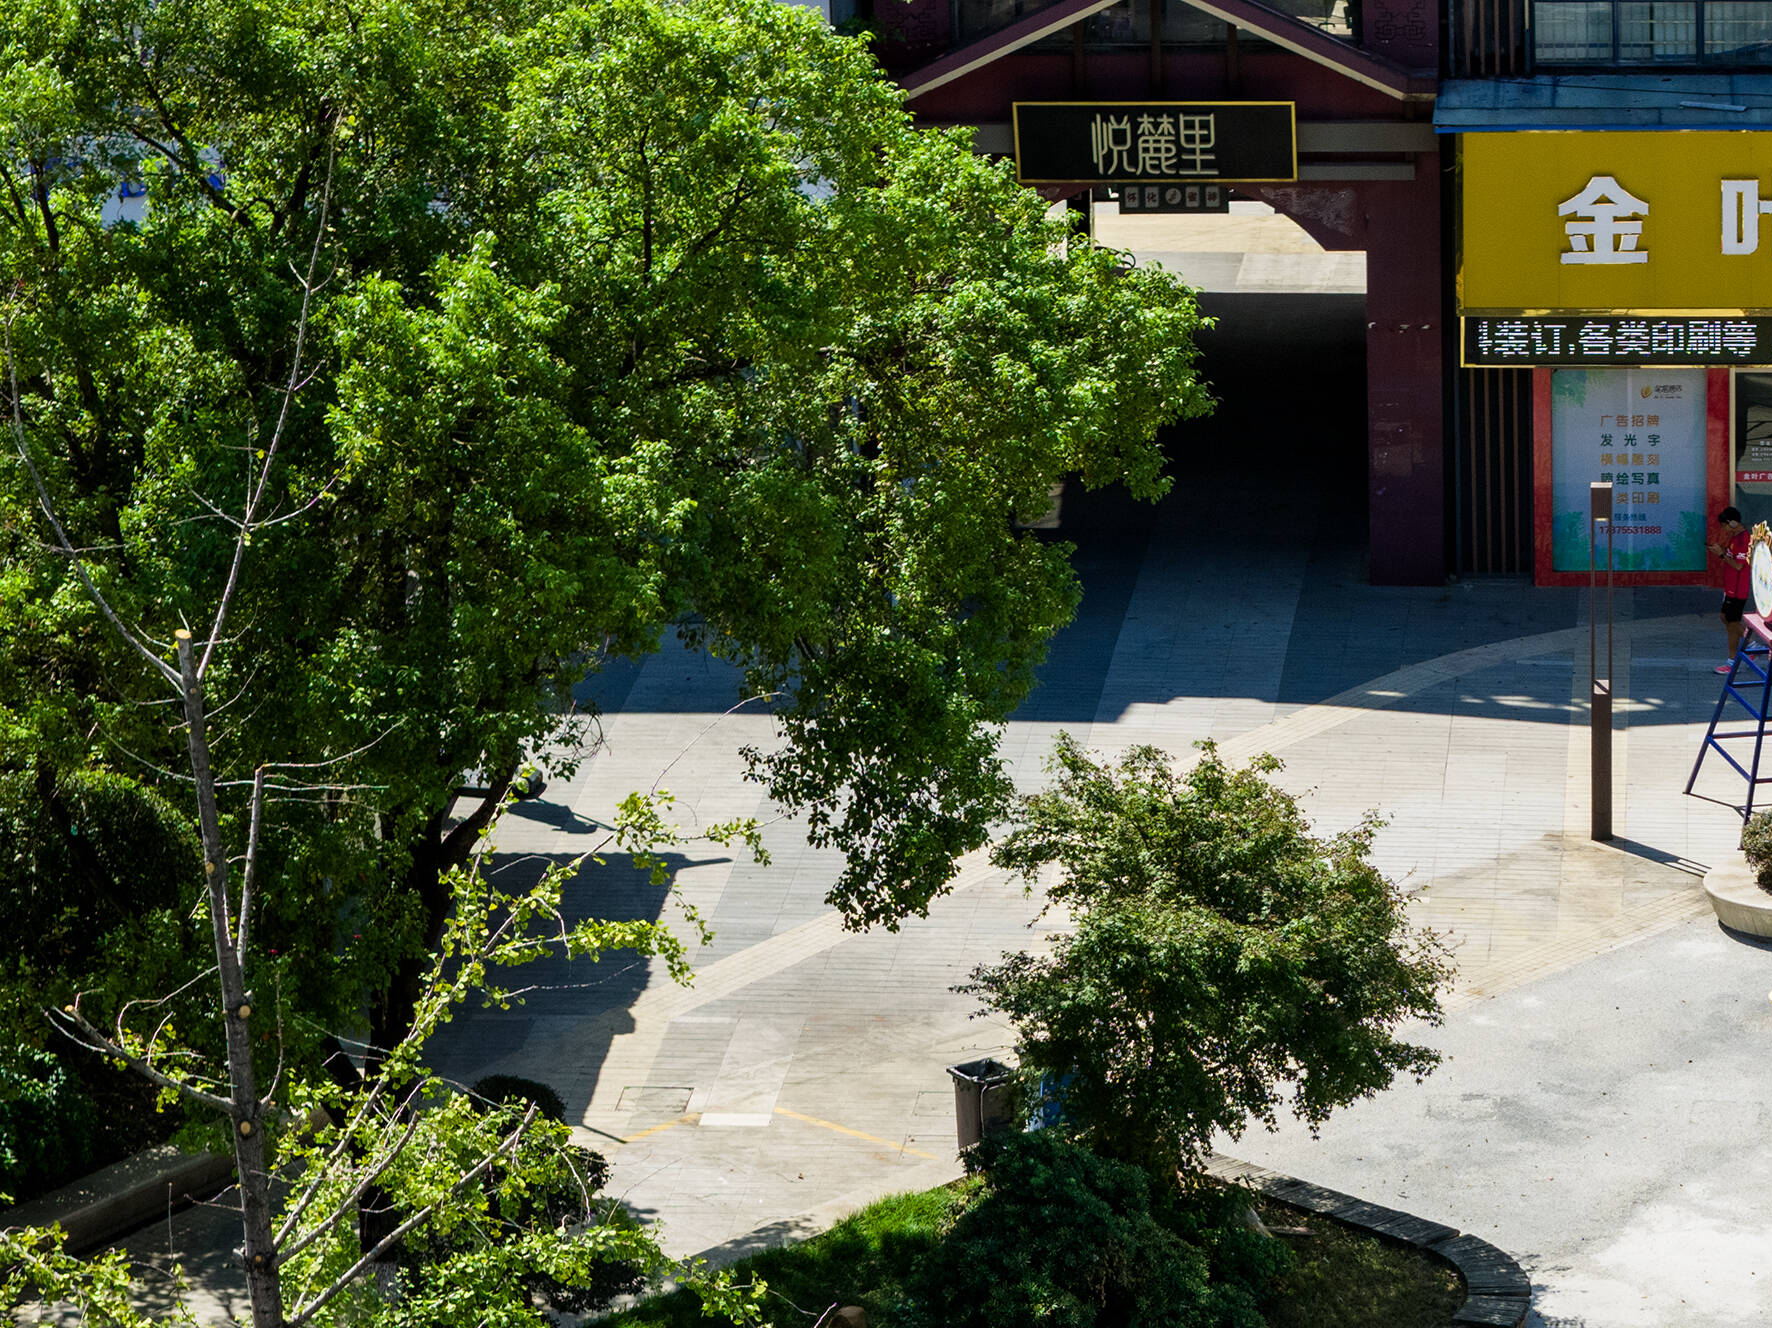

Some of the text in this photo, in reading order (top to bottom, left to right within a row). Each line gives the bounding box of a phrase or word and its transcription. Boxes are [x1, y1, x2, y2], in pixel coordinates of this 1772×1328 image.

[1091, 113, 1219, 175] 悦麓里
[1600, 415, 1660, 427] 广告招牌
[1600, 434, 1660, 447] 发光字
[1615, 492, 1660, 504] 类印刷
